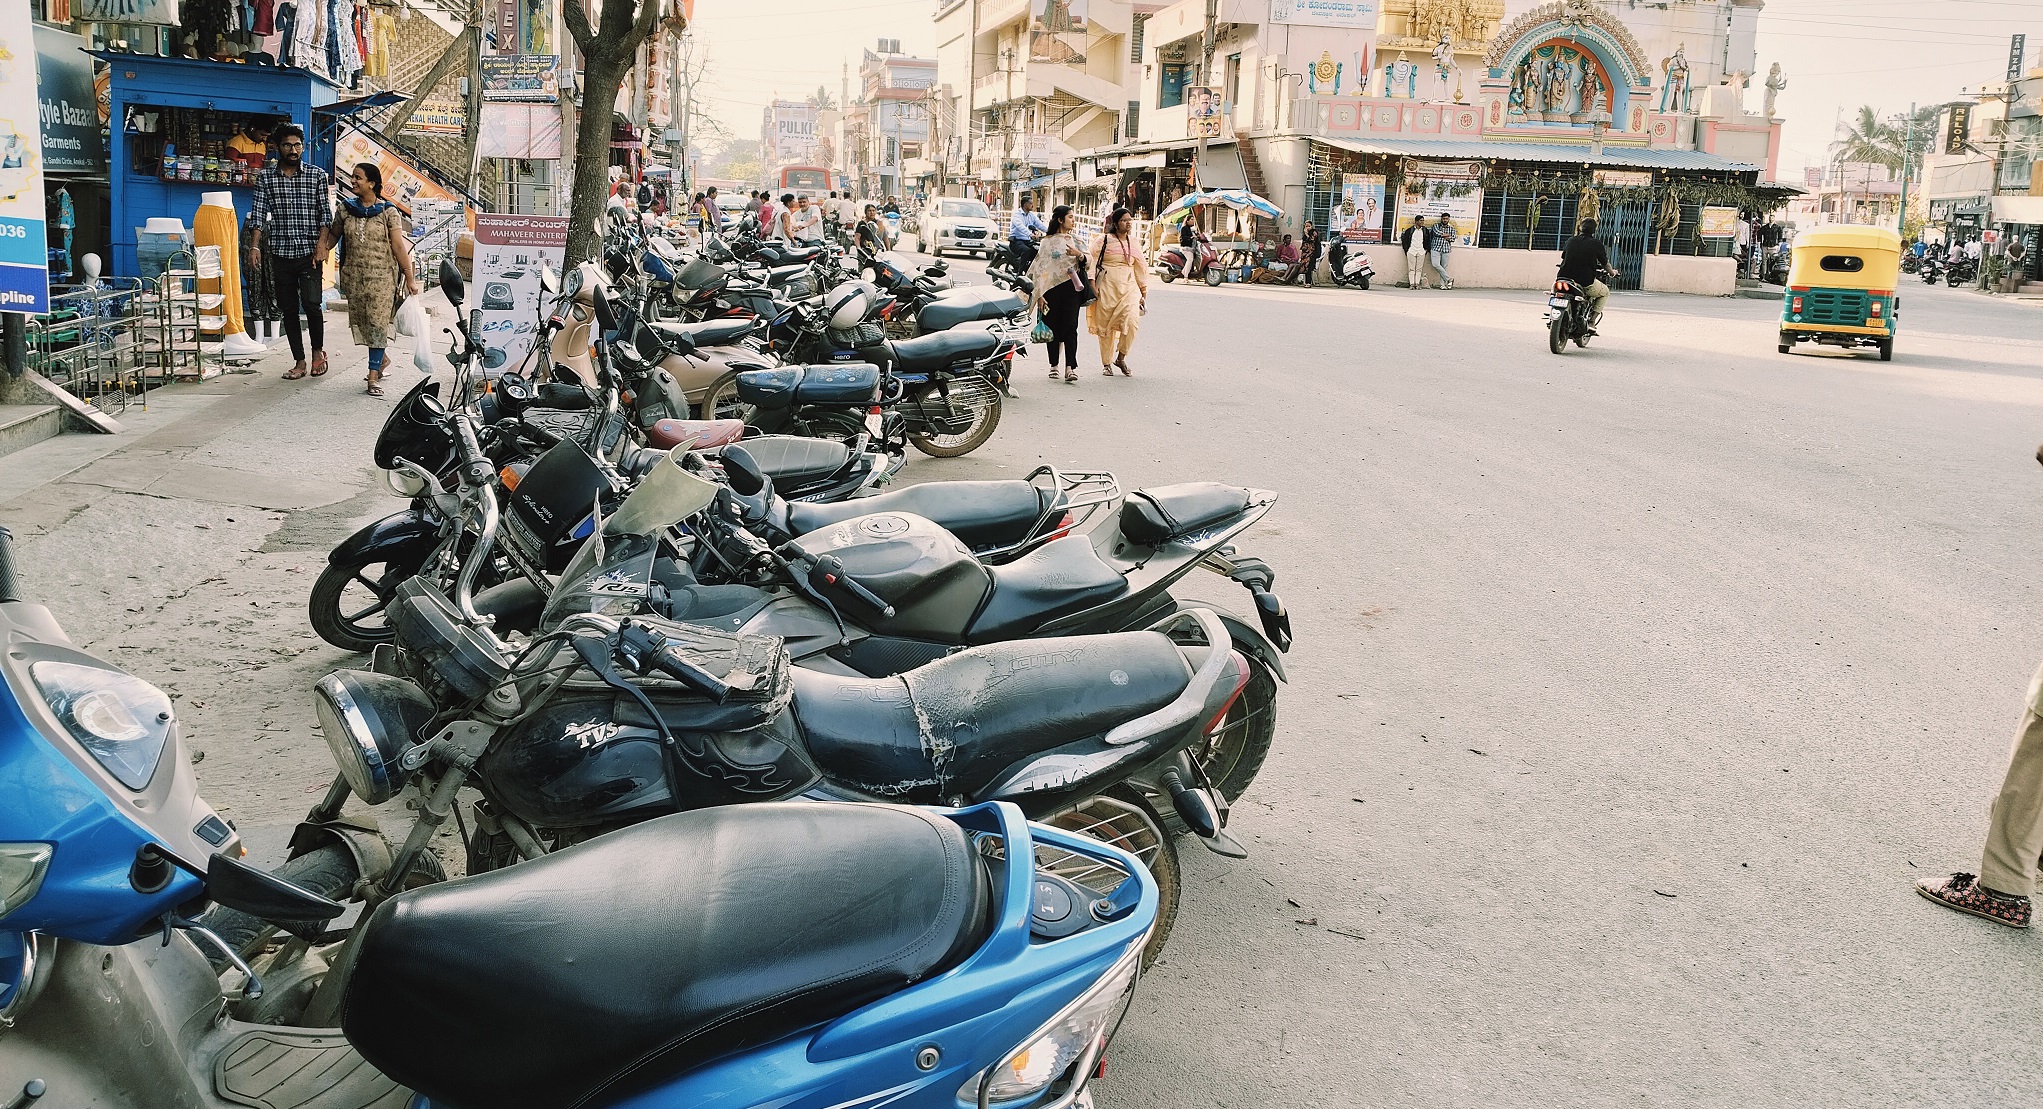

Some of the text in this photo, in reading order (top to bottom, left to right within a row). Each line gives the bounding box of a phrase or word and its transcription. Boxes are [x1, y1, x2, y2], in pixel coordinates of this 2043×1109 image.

[501, 0, 515, 50] EX
[2009, 35, 2022, 79] ZAMZAM
[61, 99, 96, 128] Bazaar
[427, 114, 448, 125] HEALTH
[41, 133, 82, 150] Garments
[1952, 108, 1965, 149] RELOAD
[490, 230, 534, 239] MAHAVEER
[576, 721, 619, 749] TVS
